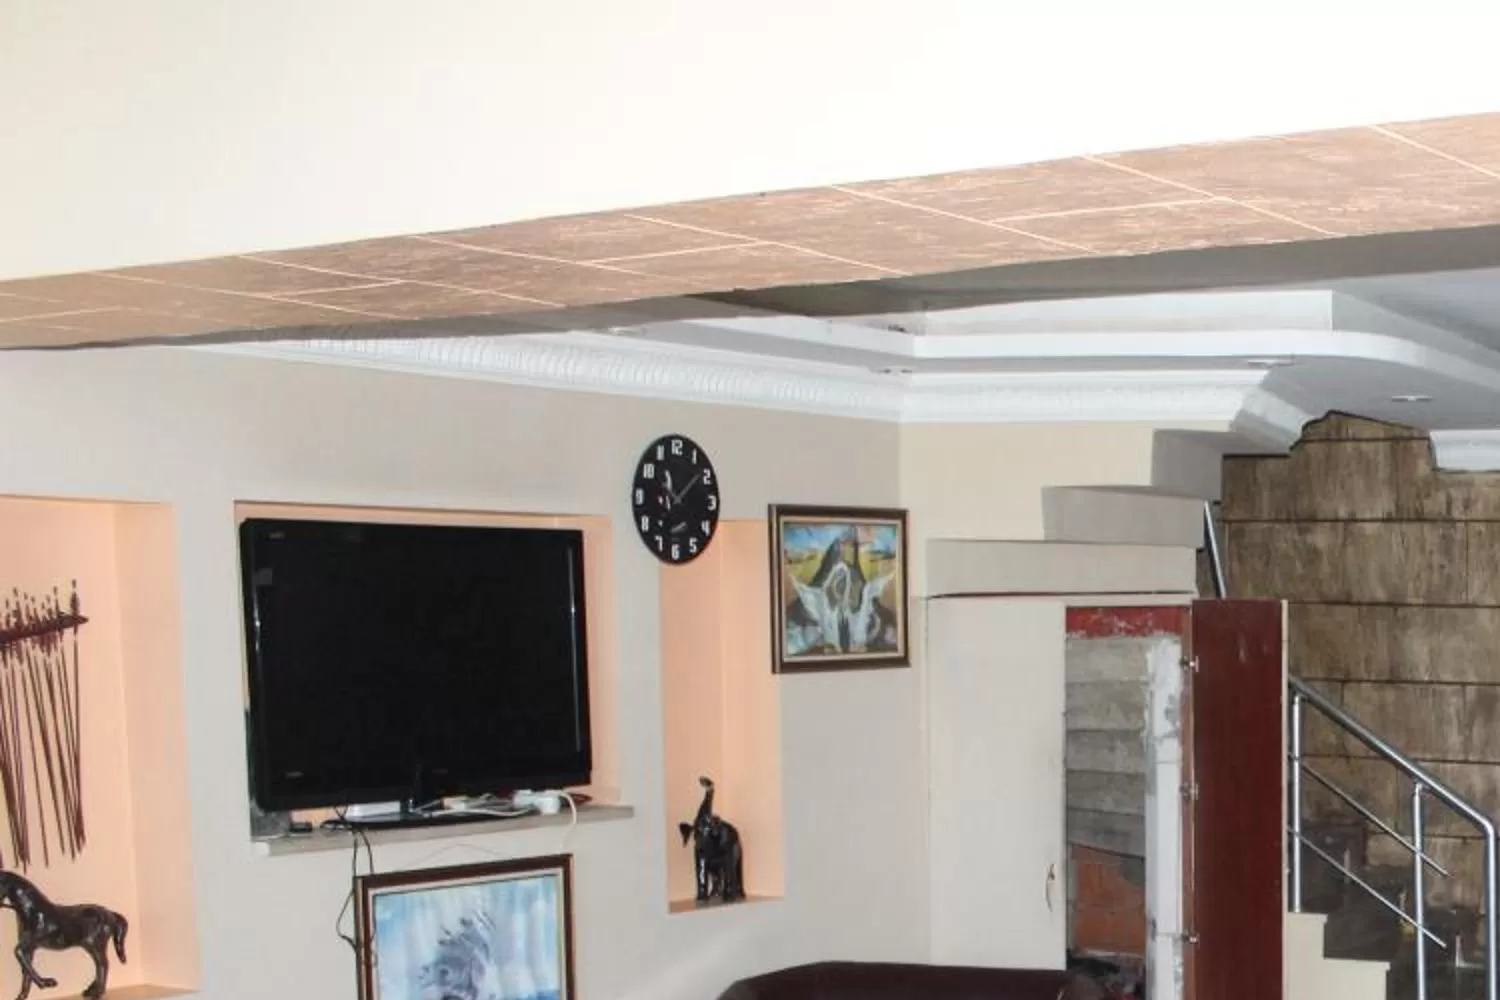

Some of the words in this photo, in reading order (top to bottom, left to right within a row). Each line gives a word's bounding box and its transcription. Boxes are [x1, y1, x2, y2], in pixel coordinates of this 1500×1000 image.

[671, 440, 683, 456] 12
[692, 448, 698, 464] 1
[644, 463, 655, 479] 10
[703, 469, 712, 485] 2
[708, 496, 717, 511] 3
[702, 520, 712, 536] 4
[654, 536, 663, 552] 7
[671, 544, 680, 560] 6
[689, 537, 698, 553] 5
